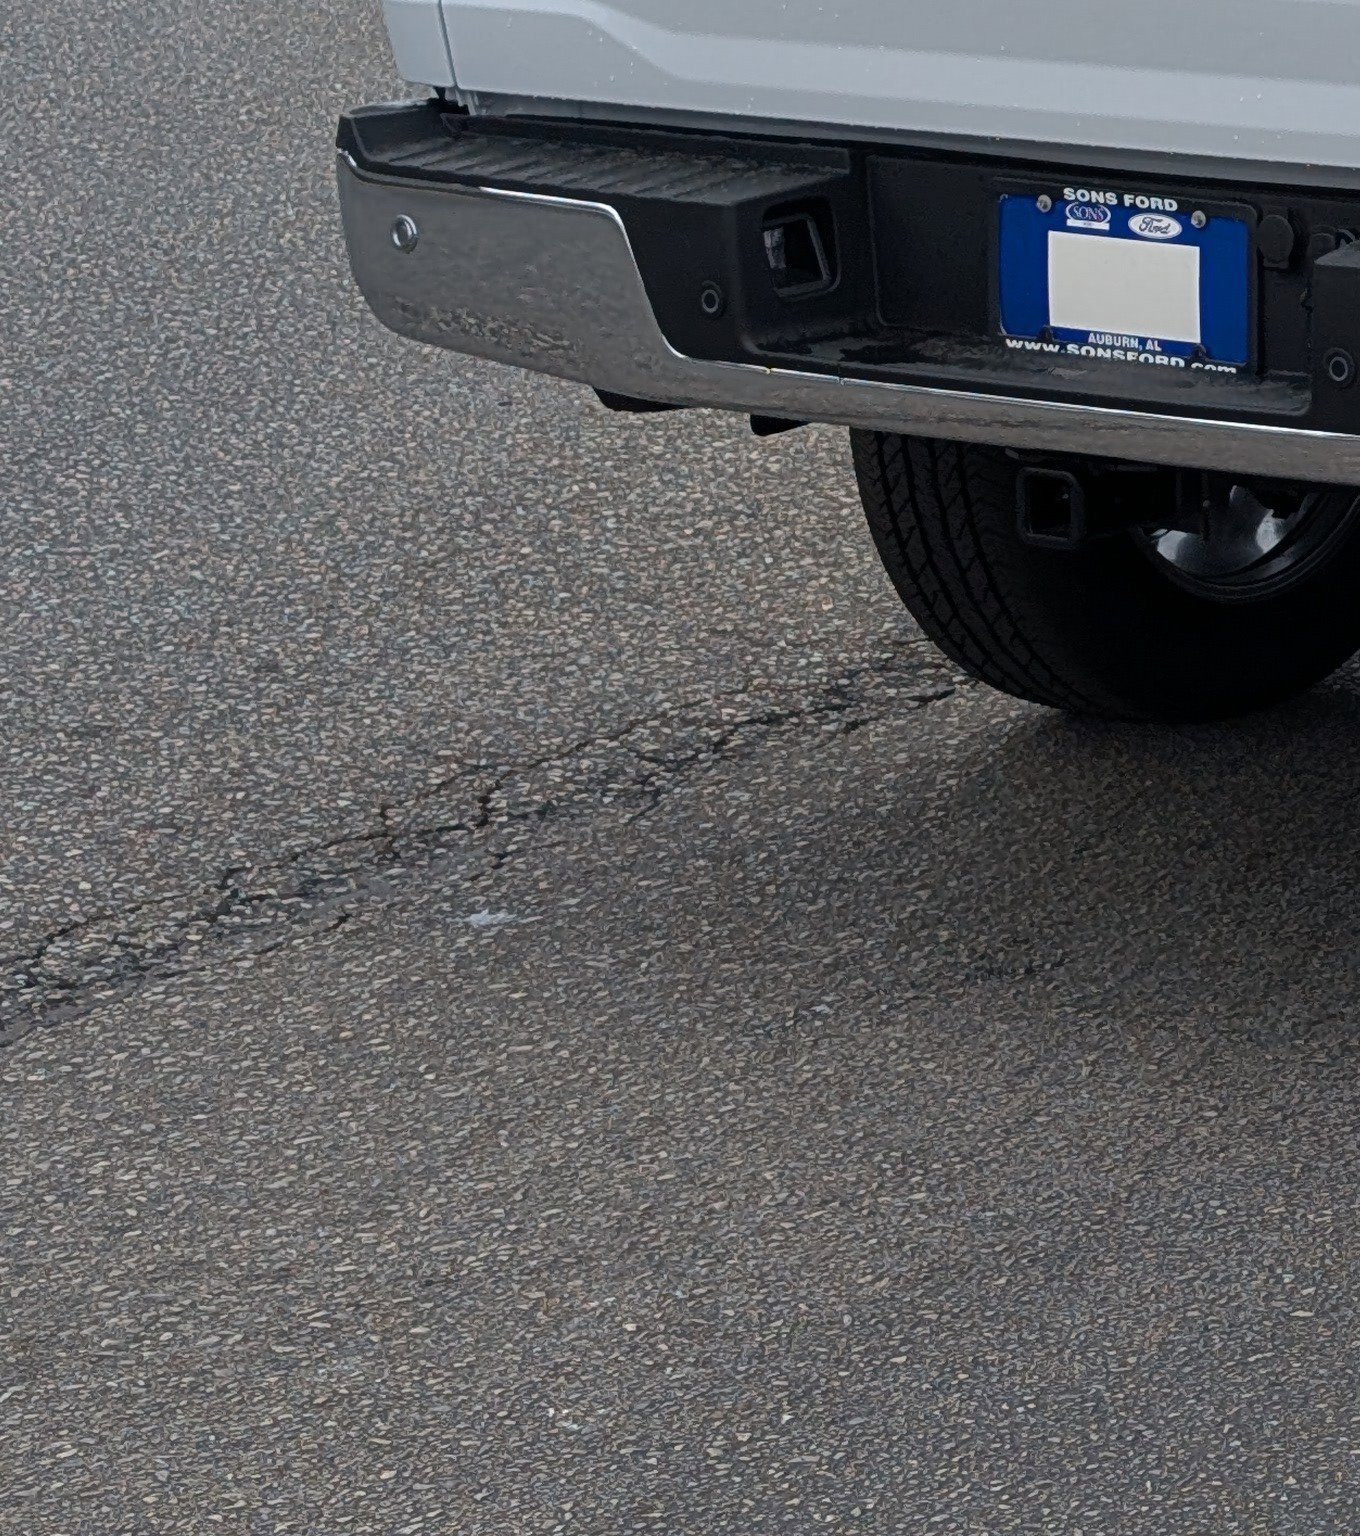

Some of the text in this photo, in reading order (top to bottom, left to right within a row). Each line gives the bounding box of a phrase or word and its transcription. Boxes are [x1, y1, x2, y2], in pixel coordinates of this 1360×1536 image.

[1063, 187, 1178, 212] SONS FORD
[1138, 216, 1171, 235] Ford
[1087, 332, 1163, 352] AUBURN, AL
